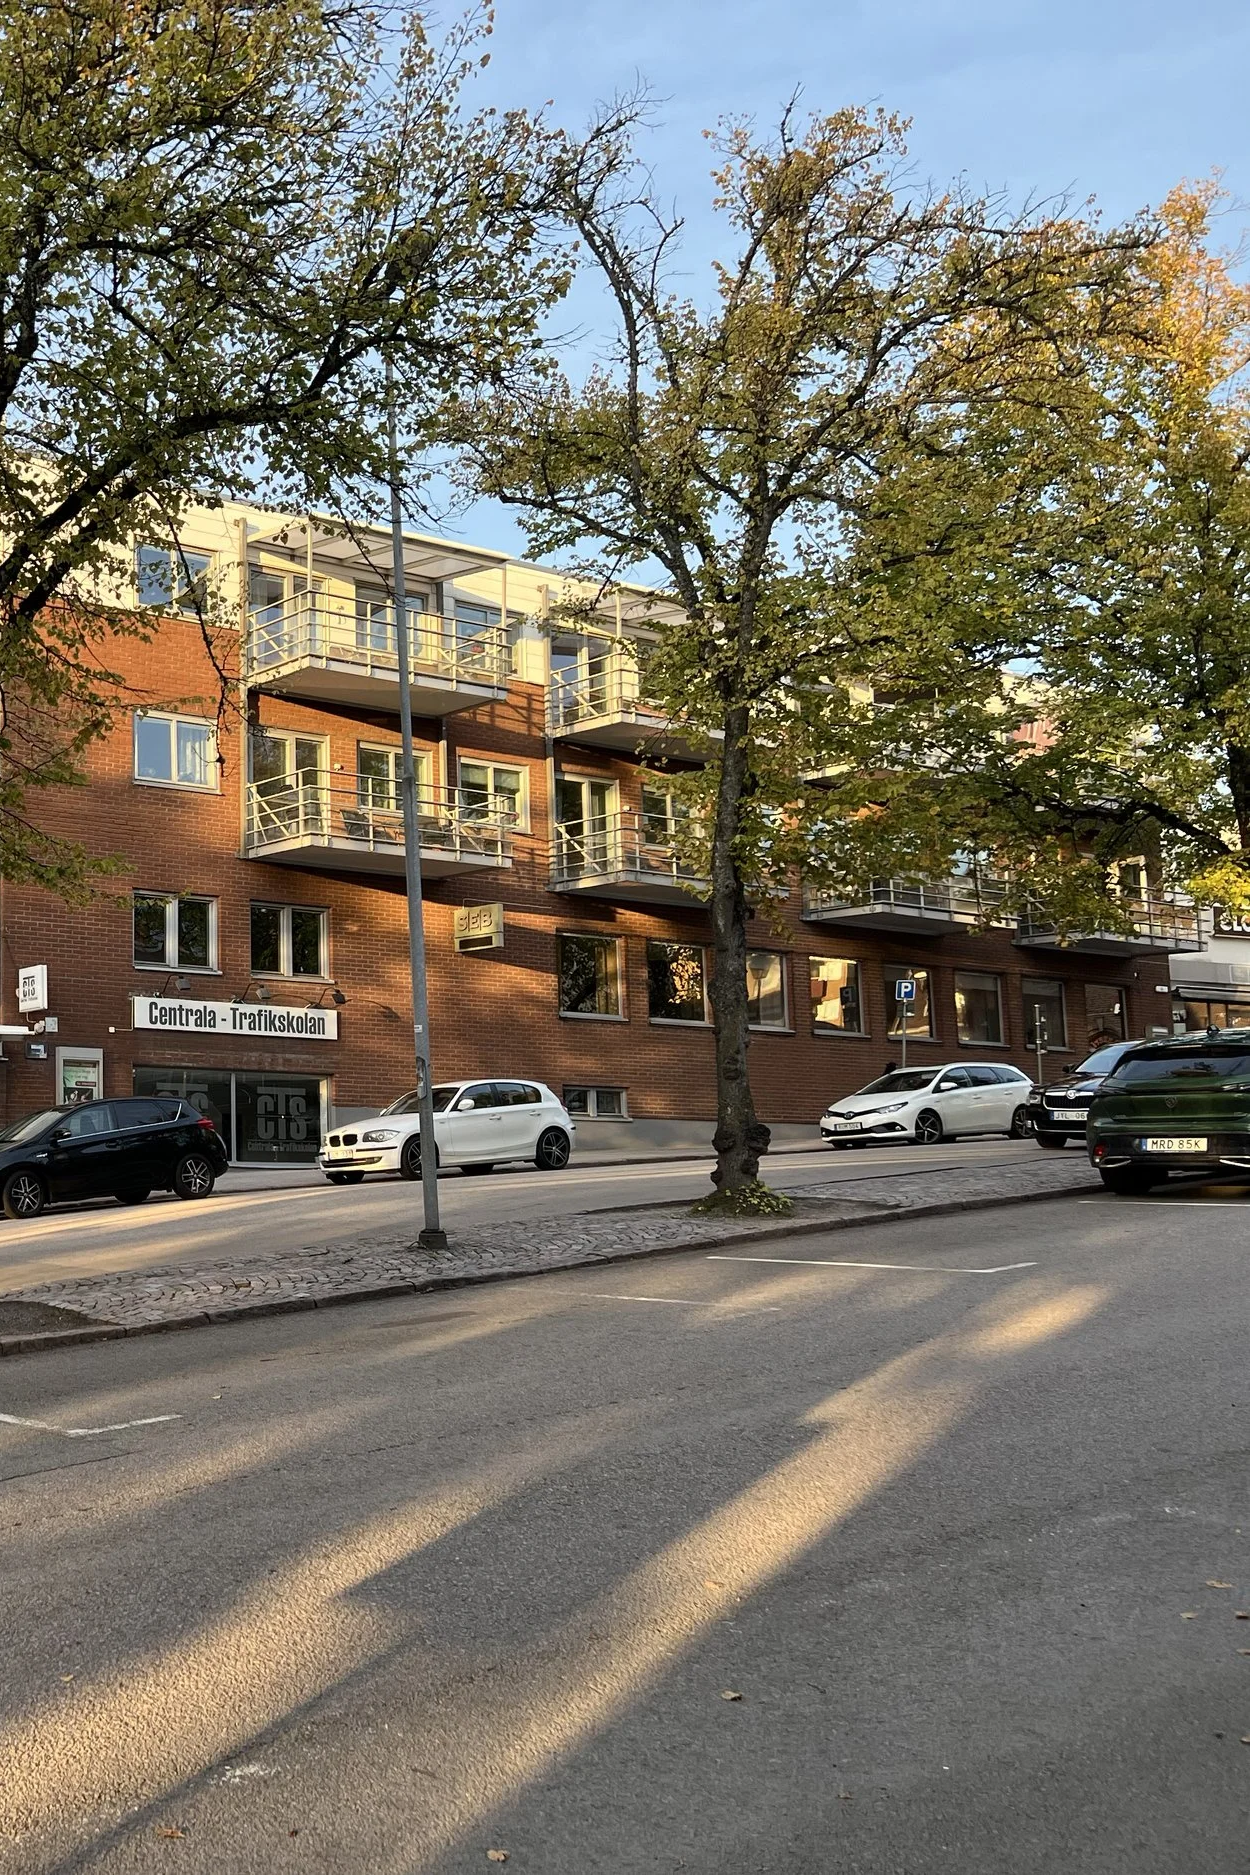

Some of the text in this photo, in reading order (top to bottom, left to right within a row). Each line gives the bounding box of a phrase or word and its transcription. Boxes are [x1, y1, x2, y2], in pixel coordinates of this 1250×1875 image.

[22, 975, 36, 998] CTS
[901, 983, 912, 998] P
[149, 1001, 217, 1029] Centrala
[230, 1007, 326, 1035] Trafikskolan
[257, 1087, 307, 1140] CTS
[1151, 1140, 1201, 1149] MRD 85K
